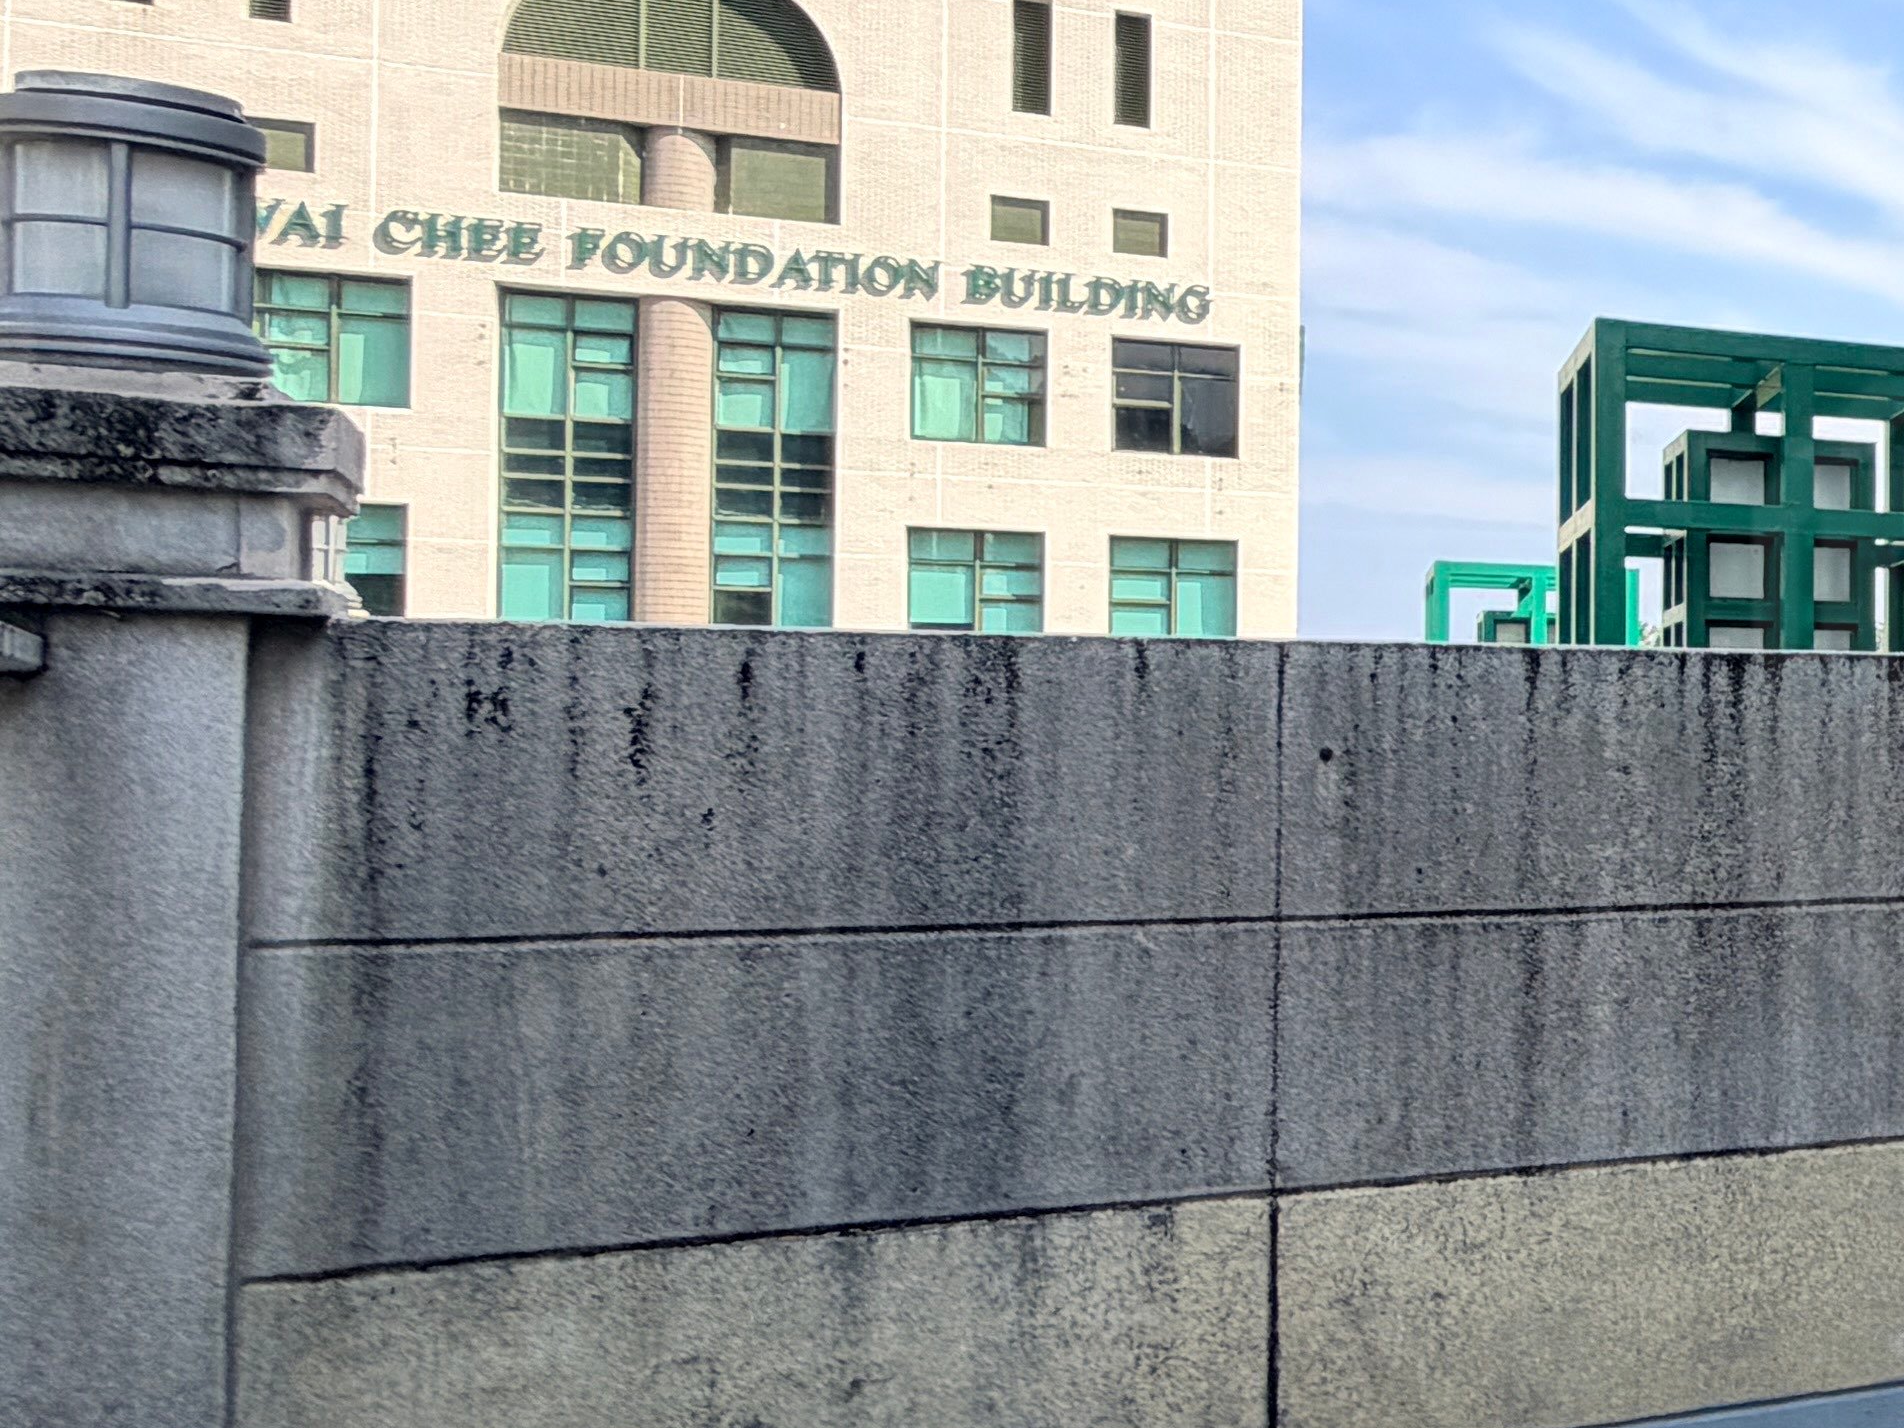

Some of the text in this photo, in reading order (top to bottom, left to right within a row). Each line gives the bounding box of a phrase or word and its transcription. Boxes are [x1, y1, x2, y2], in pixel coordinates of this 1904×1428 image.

[372, 208, 545, 266] CHEE
[565, 226, 941, 302] FOUNDATION
[960, 263, 1213, 325] BUILDING
